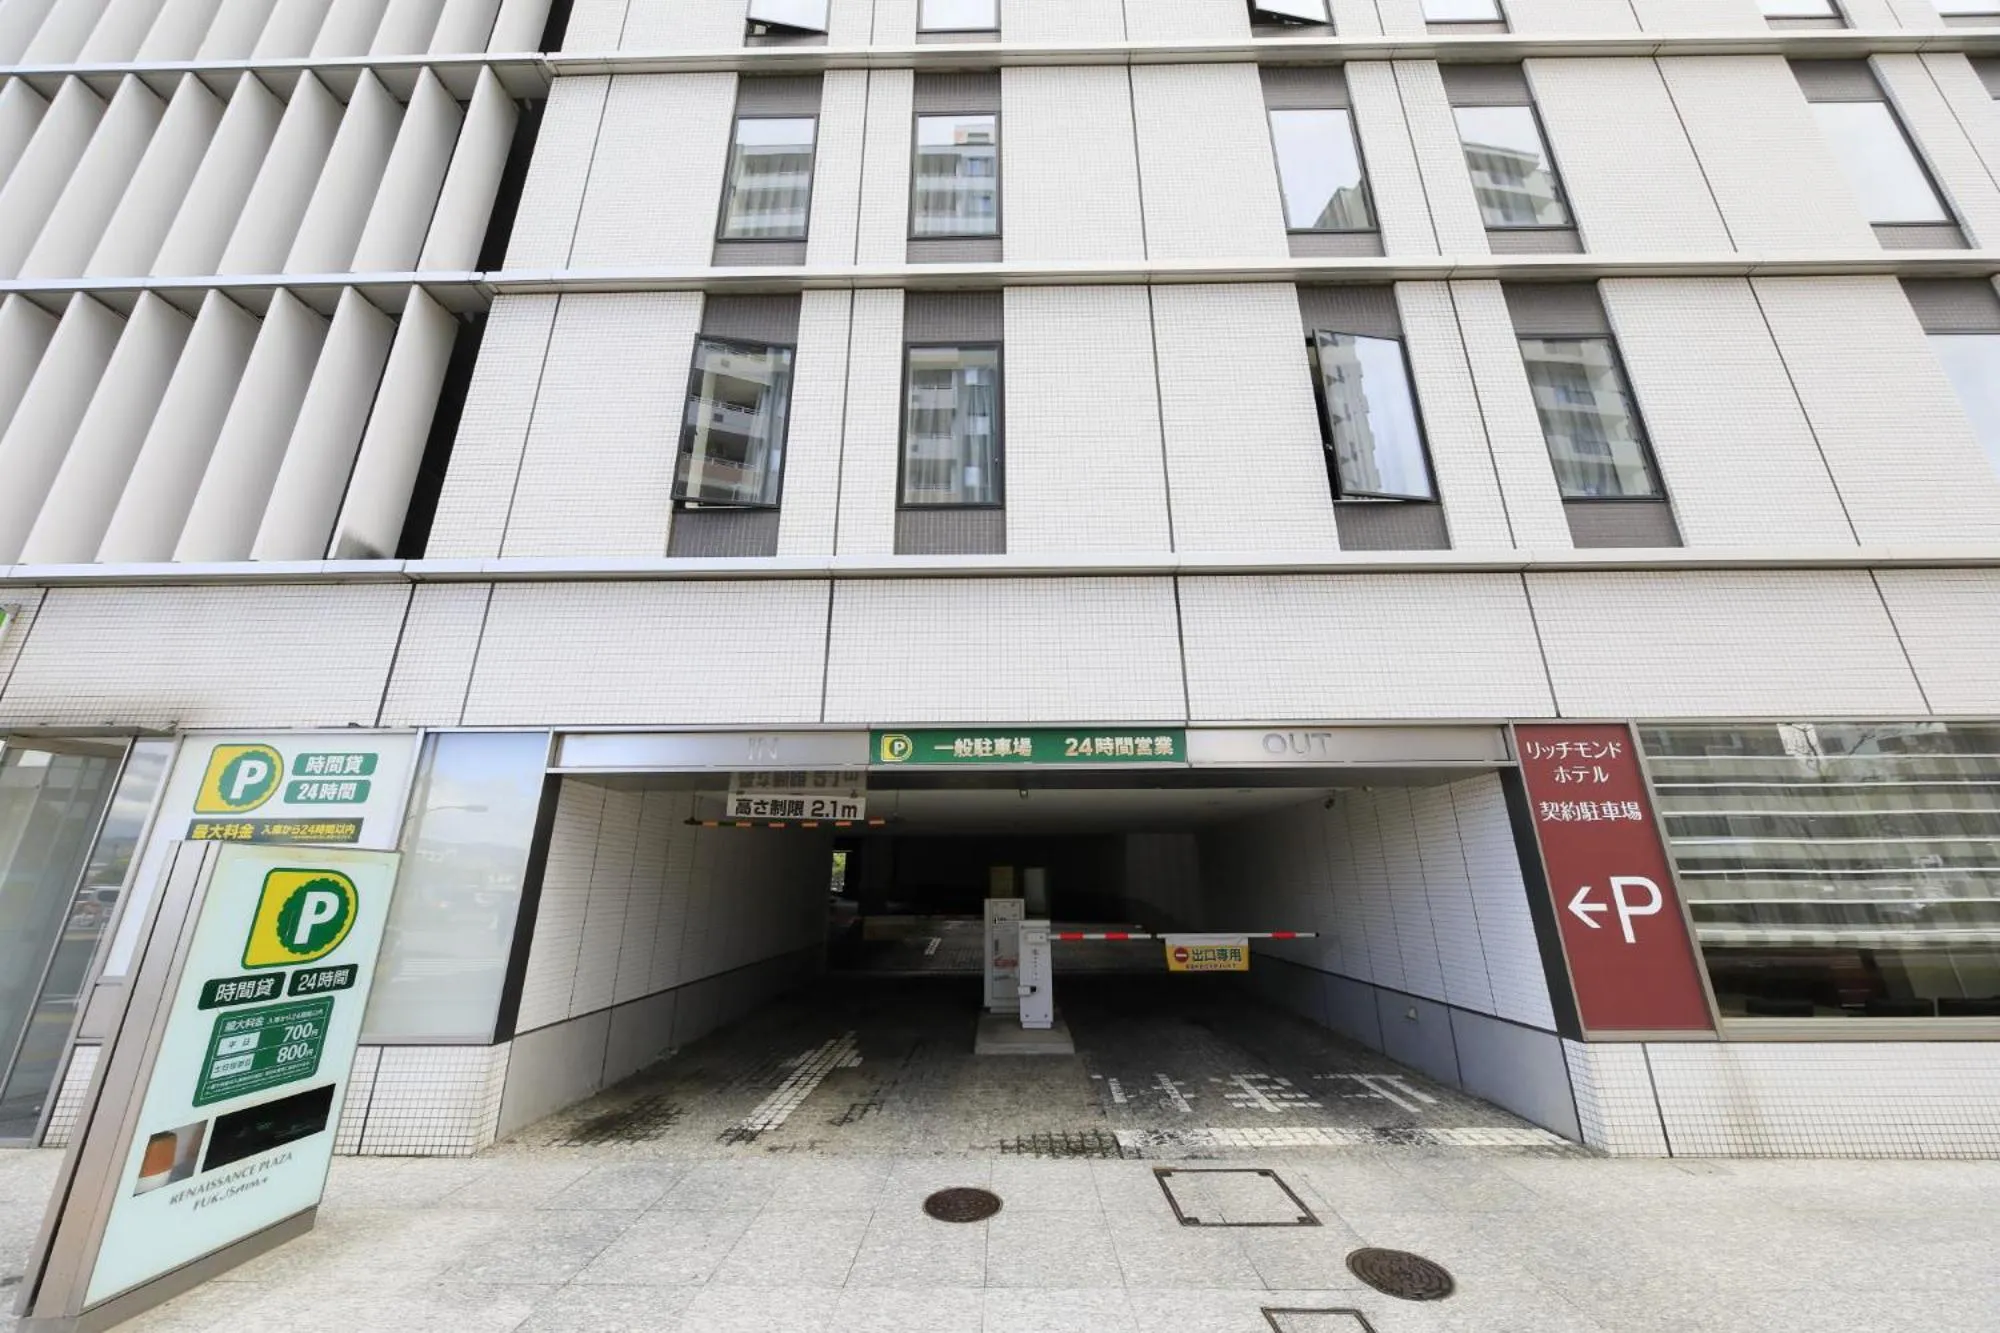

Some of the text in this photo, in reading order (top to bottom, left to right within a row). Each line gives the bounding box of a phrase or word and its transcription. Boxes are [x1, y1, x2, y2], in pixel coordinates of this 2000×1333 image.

[934, 736, 1174, 758] 一般駐車場 24時間営業
[1262, 732, 1332, 755] OUT
[1526, 741, 1622, 760] リッチモンド
[305, 755, 363, 774] 時間貸
[1553, 765, 1609, 783] ホテル
[230, 759, 268, 800] P
[296, 782, 357, 801] 24時間
[735, 798, 858, 818] 高さ制限 2.1m
[1539, 801, 1642, 822] 契約駐車場
[192, 823, 255, 840] 最大料金
[293, 891, 340, 944] P
[1610, 876, 1663, 943] P
[1192, 948, 1242, 962] 出口専用
[214, 969, 350, 1002] 時間貸 24時間
